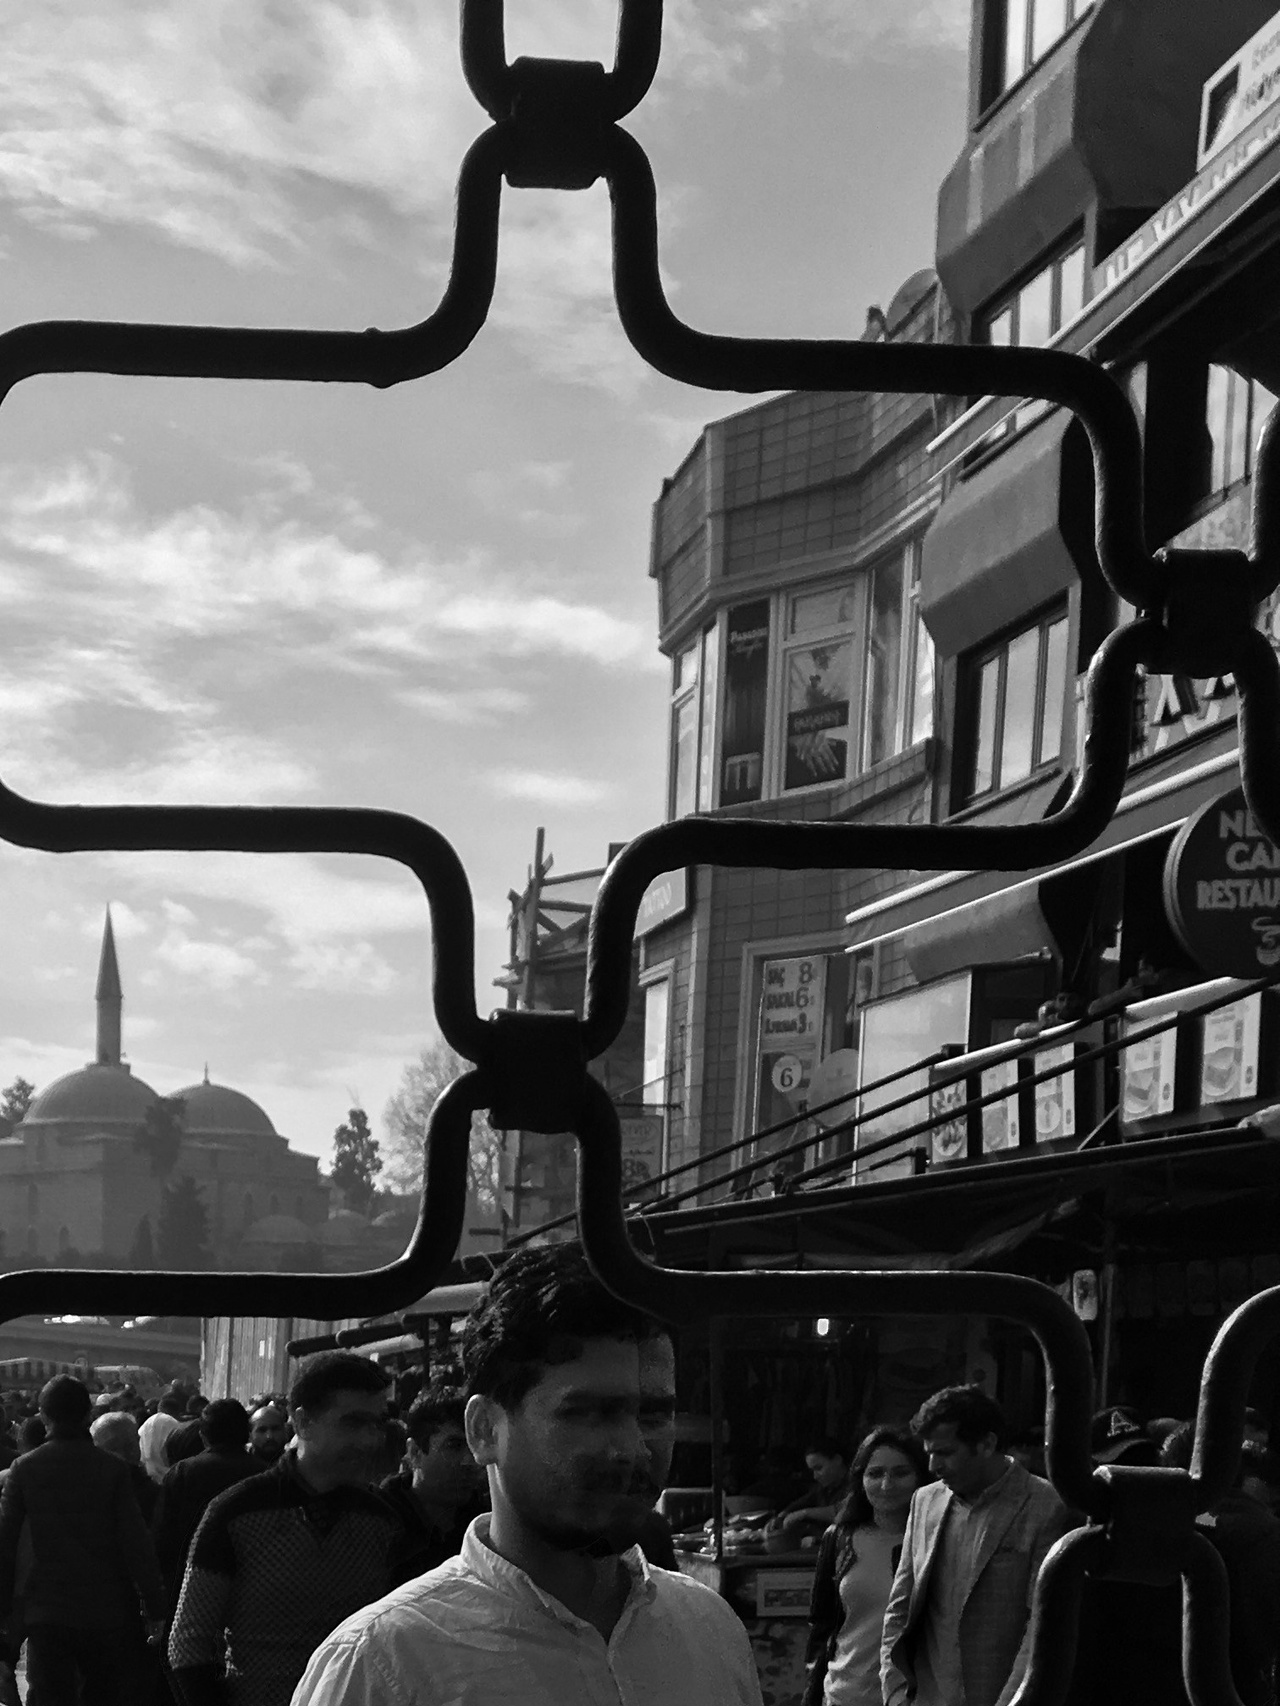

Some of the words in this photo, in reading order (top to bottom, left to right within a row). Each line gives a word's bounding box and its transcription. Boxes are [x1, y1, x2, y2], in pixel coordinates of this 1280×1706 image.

[1219, 809, 1265, 838] NE
[799, 962, 813, 984] 8
[796, 986, 810, 1008] 6
[780, 1067, 794, 1088] 6
[1107, 1410, 1140, 1437] A
